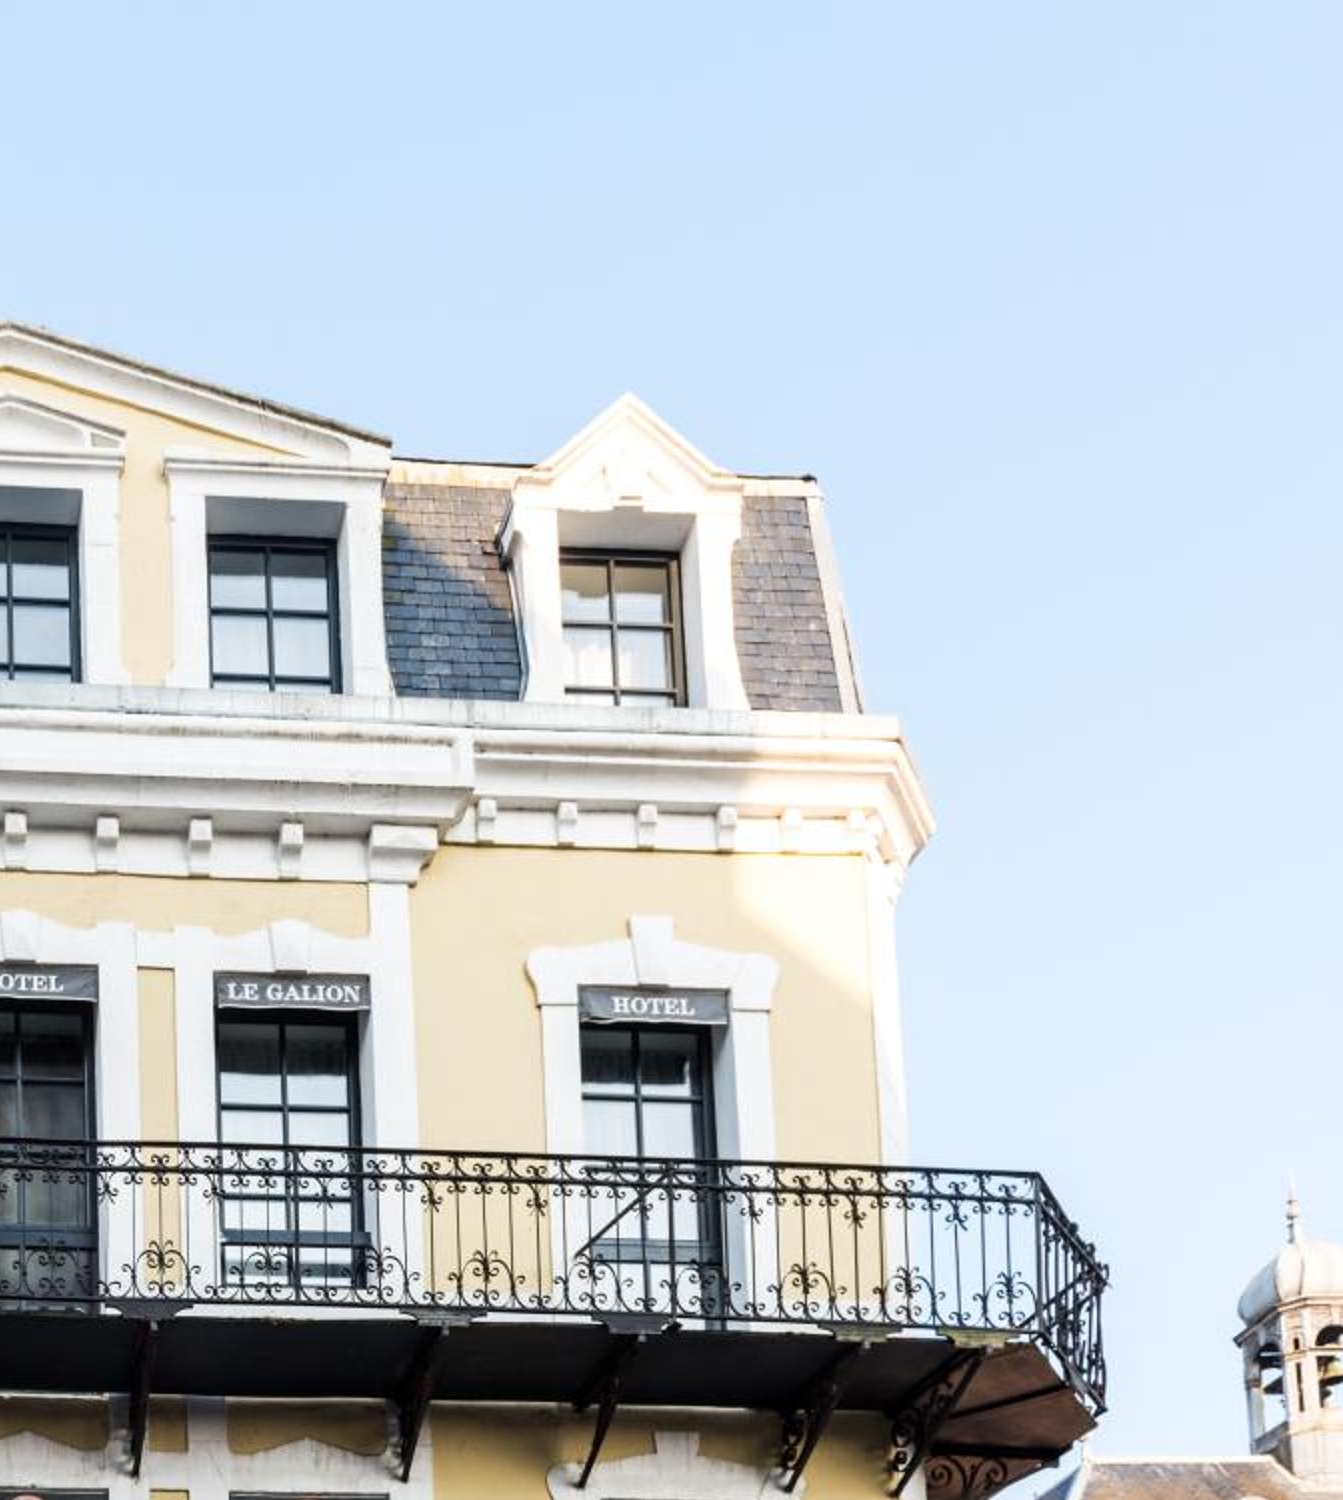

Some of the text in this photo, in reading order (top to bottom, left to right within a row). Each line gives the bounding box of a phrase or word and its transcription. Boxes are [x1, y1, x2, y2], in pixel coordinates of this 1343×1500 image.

[227, 982, 360, 1004] LE GALION
[611, 996, 696, 1018] HOTEL
